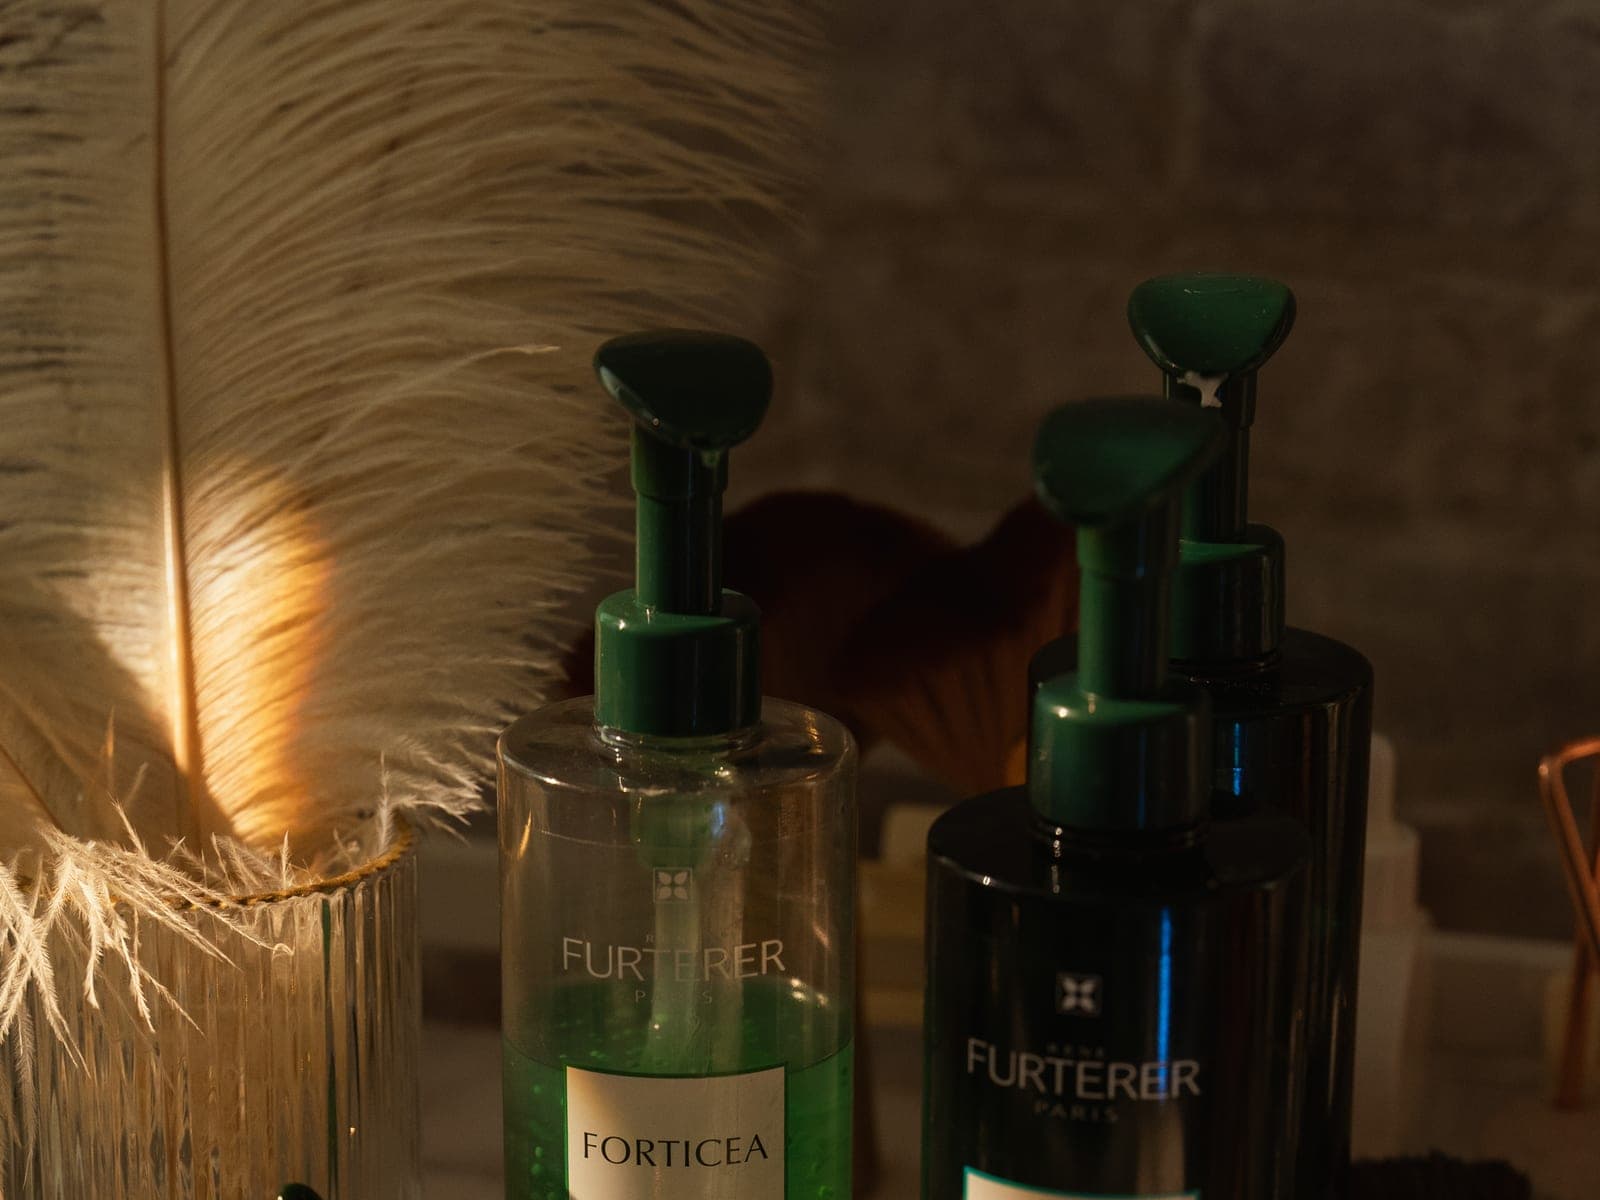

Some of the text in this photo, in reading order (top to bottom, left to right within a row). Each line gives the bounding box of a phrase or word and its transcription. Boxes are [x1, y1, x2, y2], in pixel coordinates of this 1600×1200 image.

[563, 936, 786, 982] FURTERER
[967, 1037, 1201, 1101] FURTERER
[583, 1132, 769, 1168] FORTICEA
